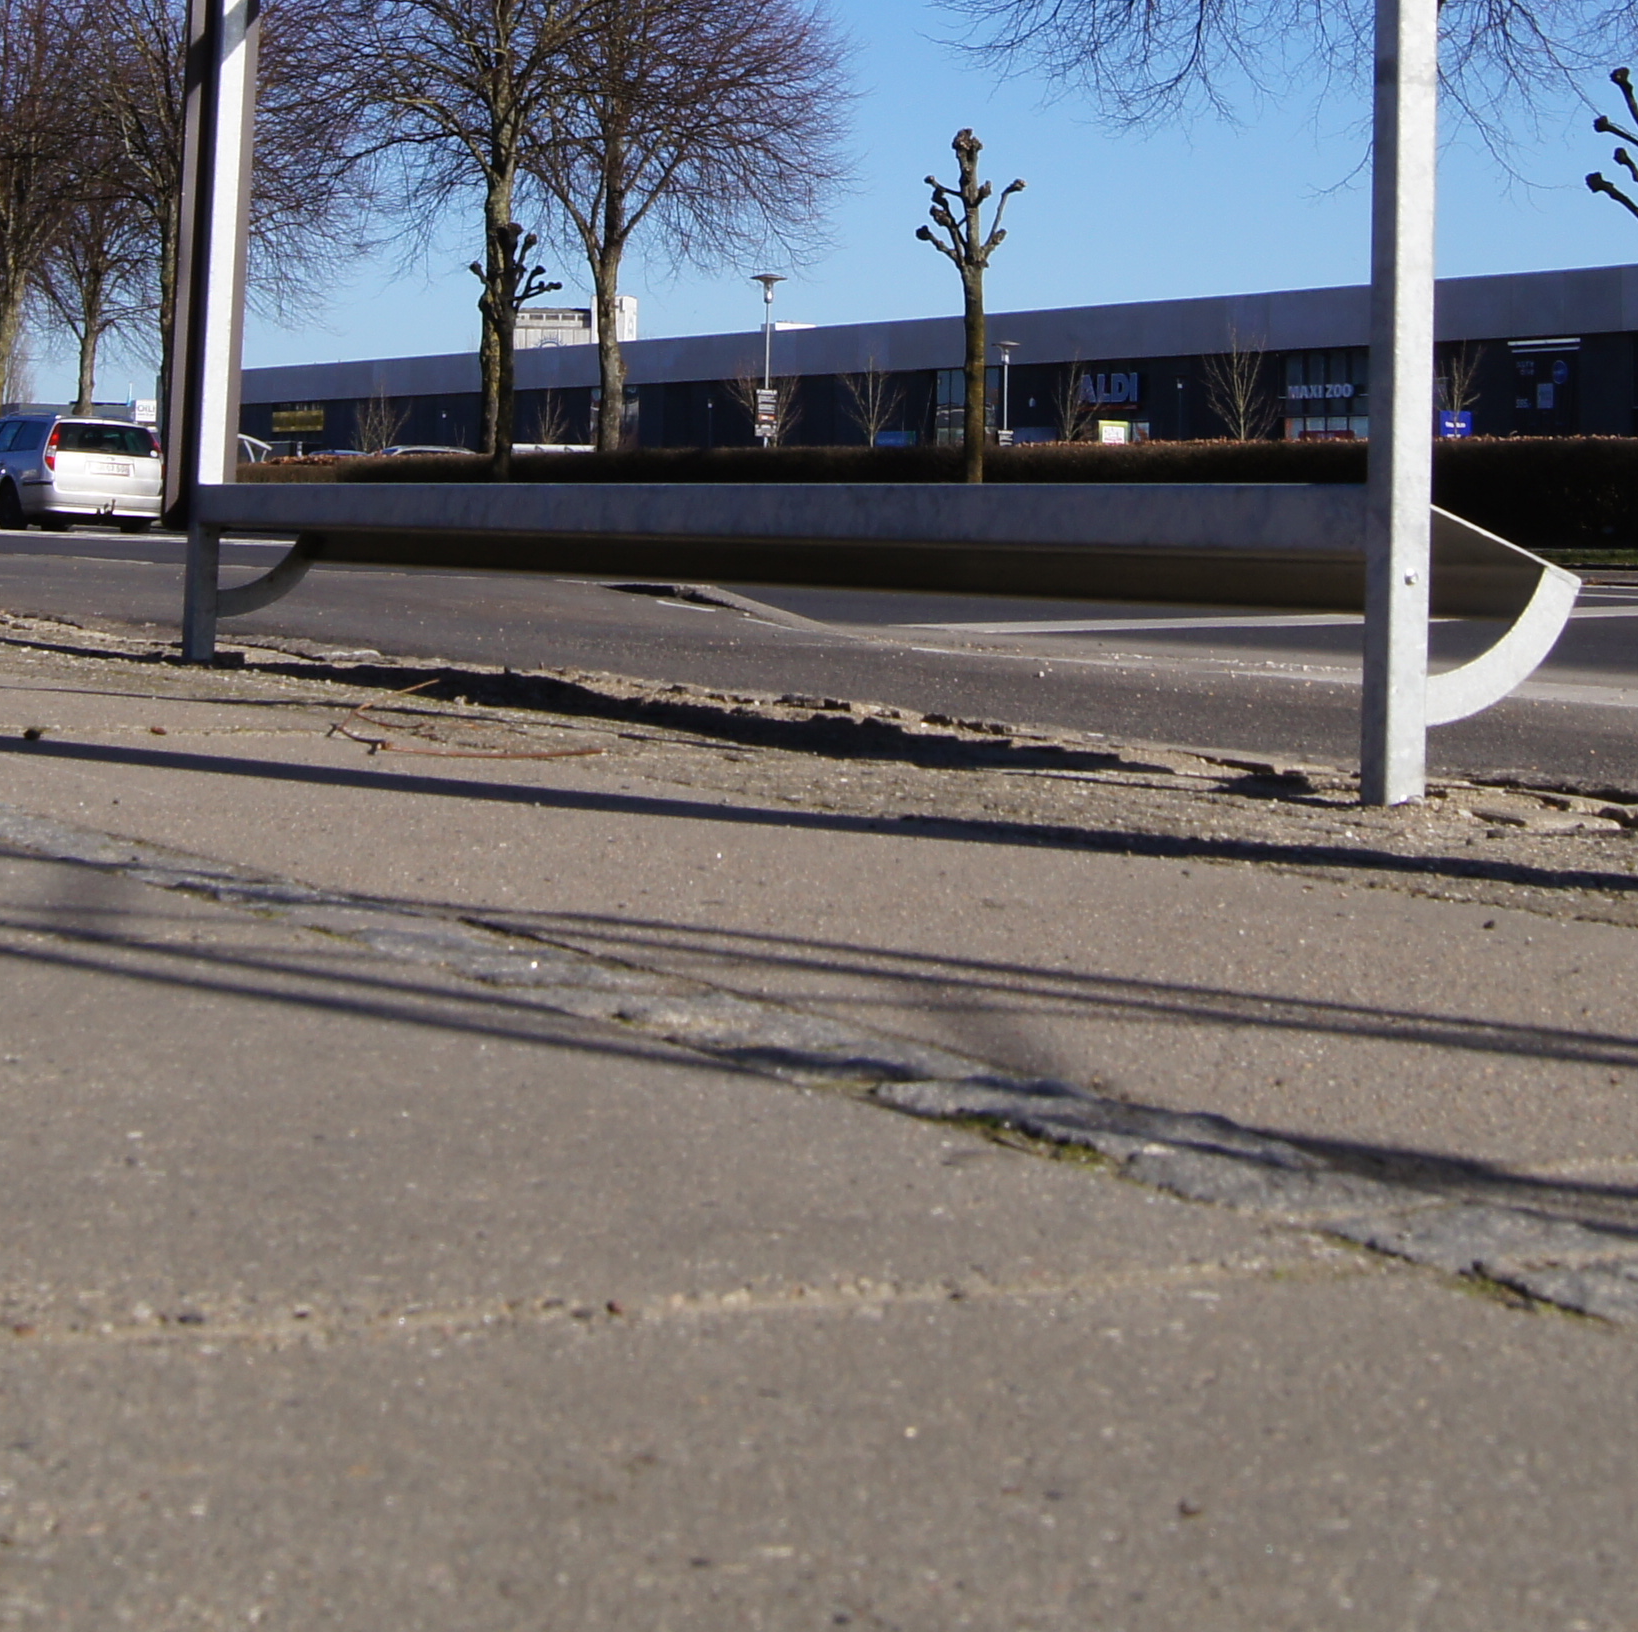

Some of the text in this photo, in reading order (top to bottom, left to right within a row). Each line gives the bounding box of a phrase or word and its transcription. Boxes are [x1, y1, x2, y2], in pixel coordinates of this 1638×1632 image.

[1078, 372, 1138, 403] ALDI
[1288, 383, 1354, 399] MAXI ZOO
